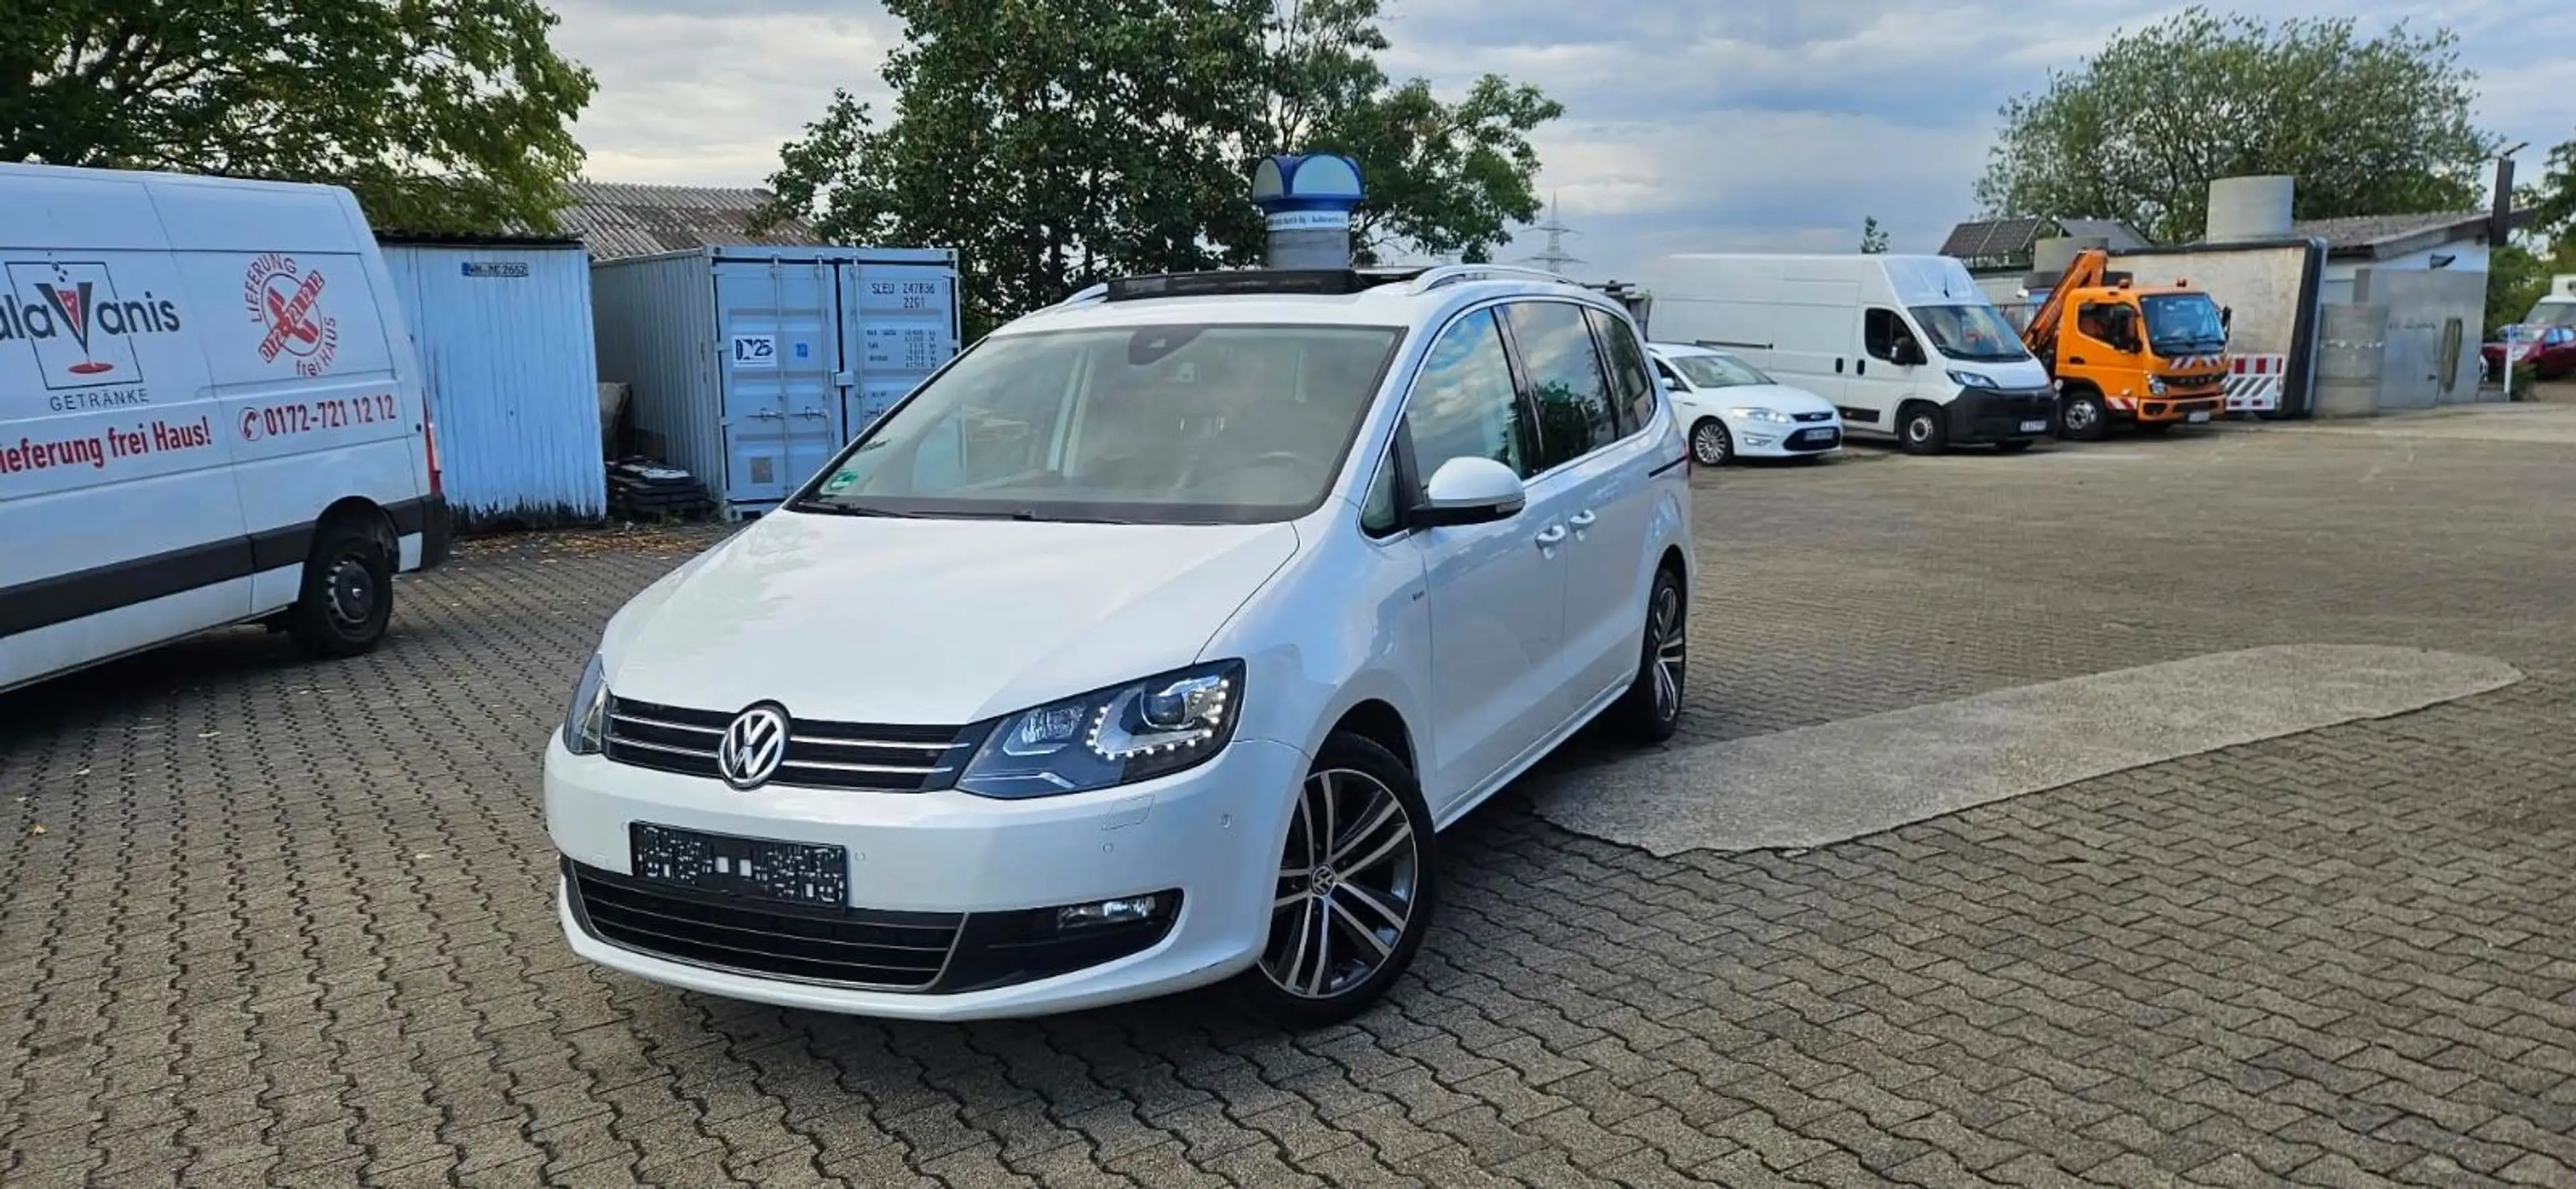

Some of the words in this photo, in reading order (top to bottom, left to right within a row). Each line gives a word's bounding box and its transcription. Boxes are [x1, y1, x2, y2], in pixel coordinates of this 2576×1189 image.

[244, 252, 297, 323] LIEFERUNG
[871, 283, 894, 294] SLEU
[50, 388, 150, 412] GETRÄNKE
[264, 399, 347, 436] 0172-721
[352, 396, 374, 424] 12
[376, 394, 396, 421] 12
[107, 422, 149, 459] frei
[152, 414, 212, 451] Haus!
